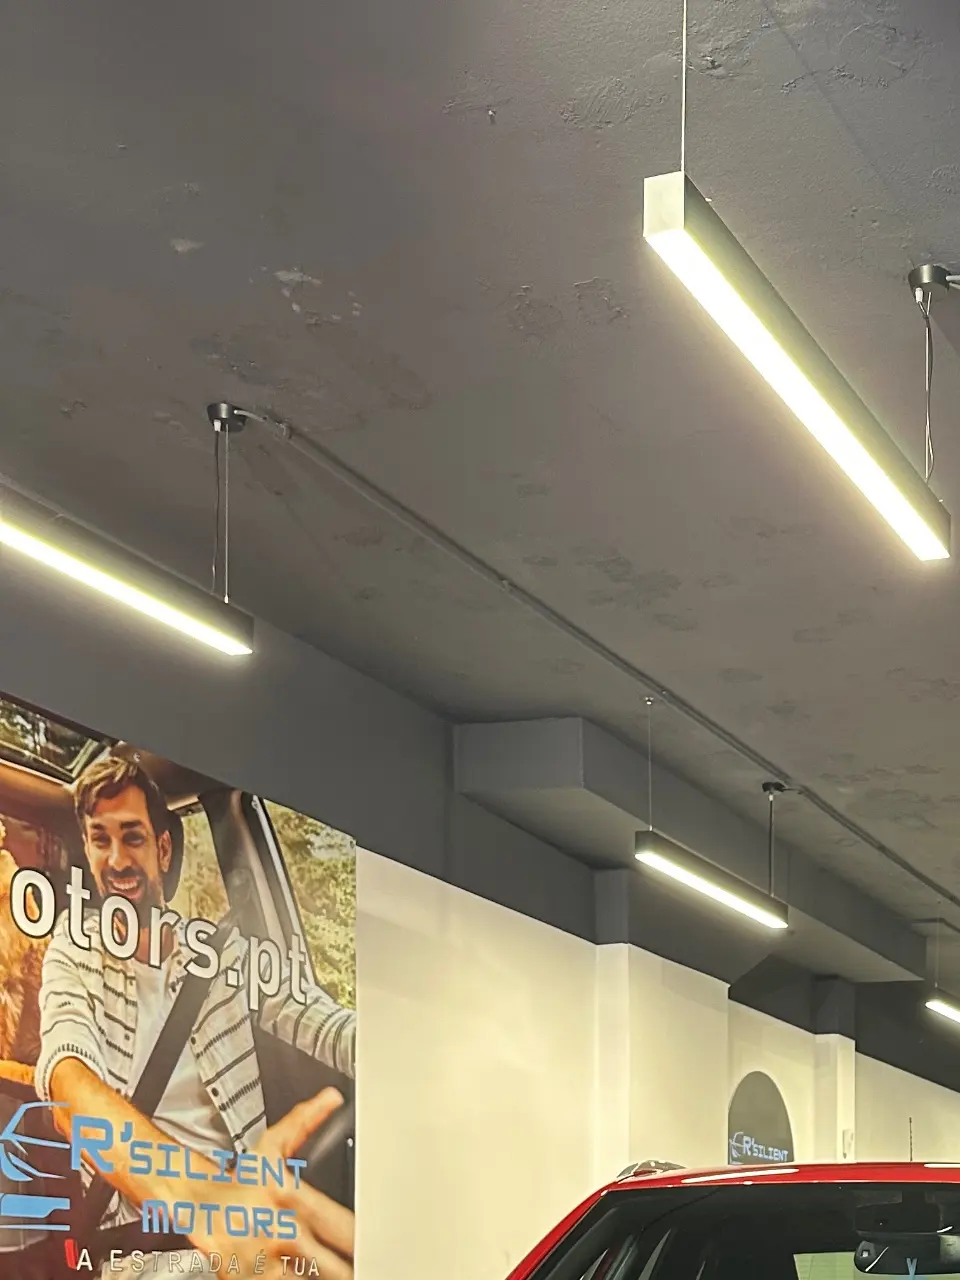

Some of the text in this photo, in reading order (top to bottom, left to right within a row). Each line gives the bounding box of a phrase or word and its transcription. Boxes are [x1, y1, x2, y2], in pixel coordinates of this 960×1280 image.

[11, 866, 307, 1010] otors.pt
[71, 1114, 308, 1190] R'SILIENT
[142, 1199, 298, 1240] MOTORS
[77, 1248, 320, 1277] A ESTRADA É TUA
